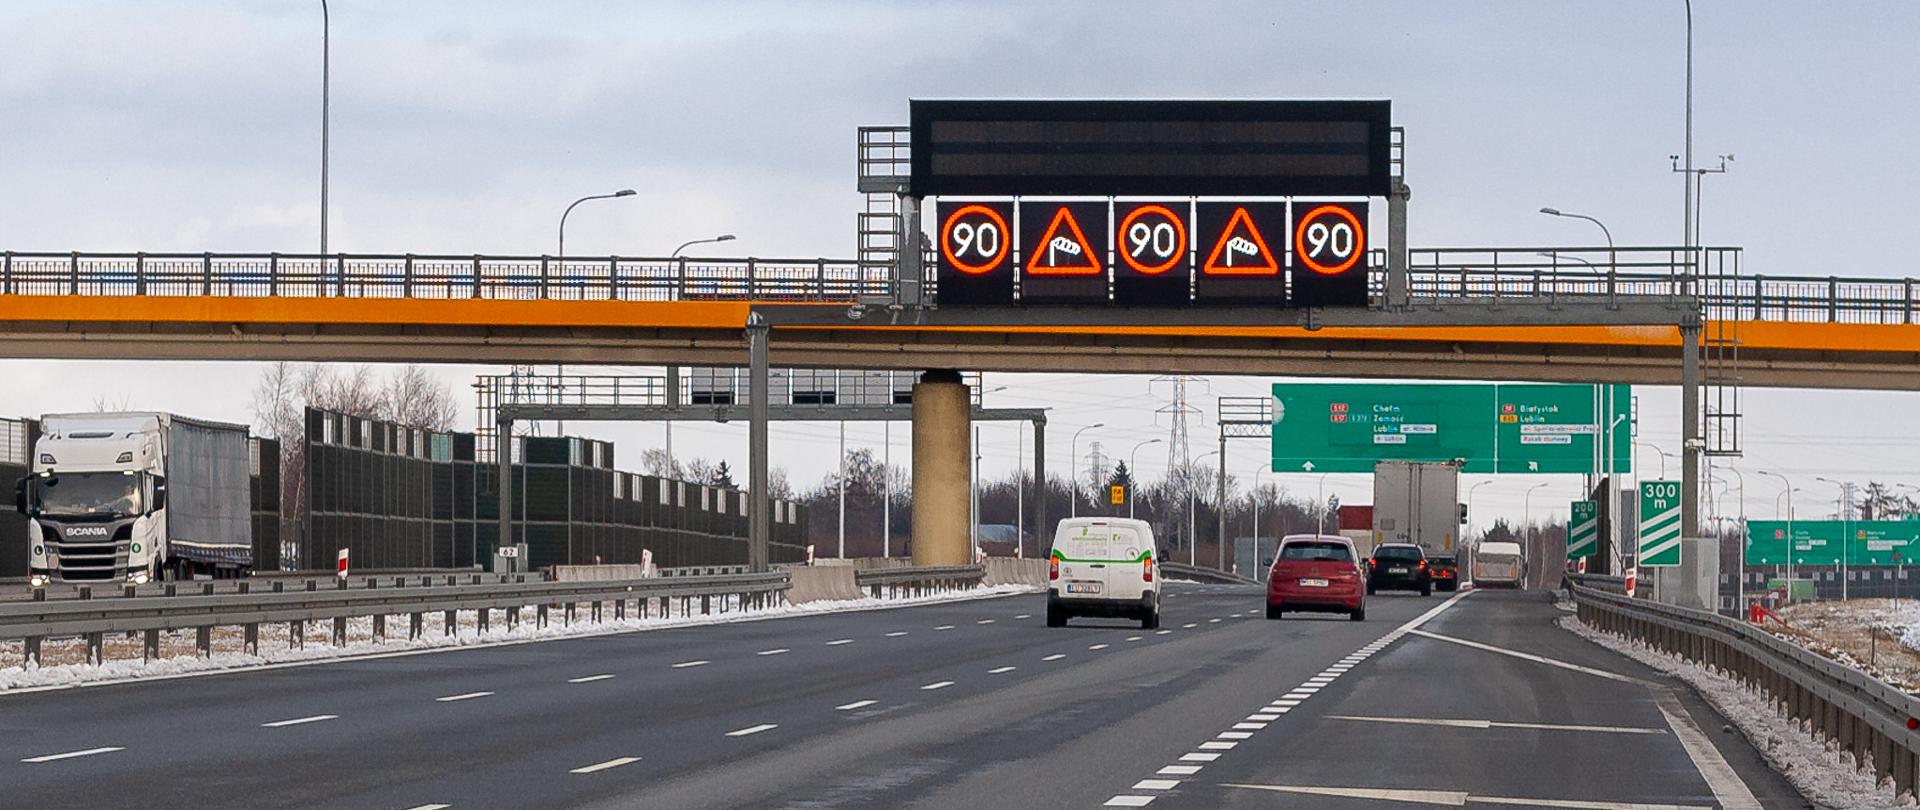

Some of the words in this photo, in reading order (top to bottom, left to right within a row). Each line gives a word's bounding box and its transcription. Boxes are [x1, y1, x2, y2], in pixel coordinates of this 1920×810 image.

[953, 223, 998, 257] 90
[1129, 223, 1175, 257] 90
[1307, 223, 1353, 257] 90
[1645, 484, 1676, 498] 300
[1574, 503, 1594, 512] 200
[1654, 499, 1667, 509] m
[66, 527, 107, 536] SCANIA
